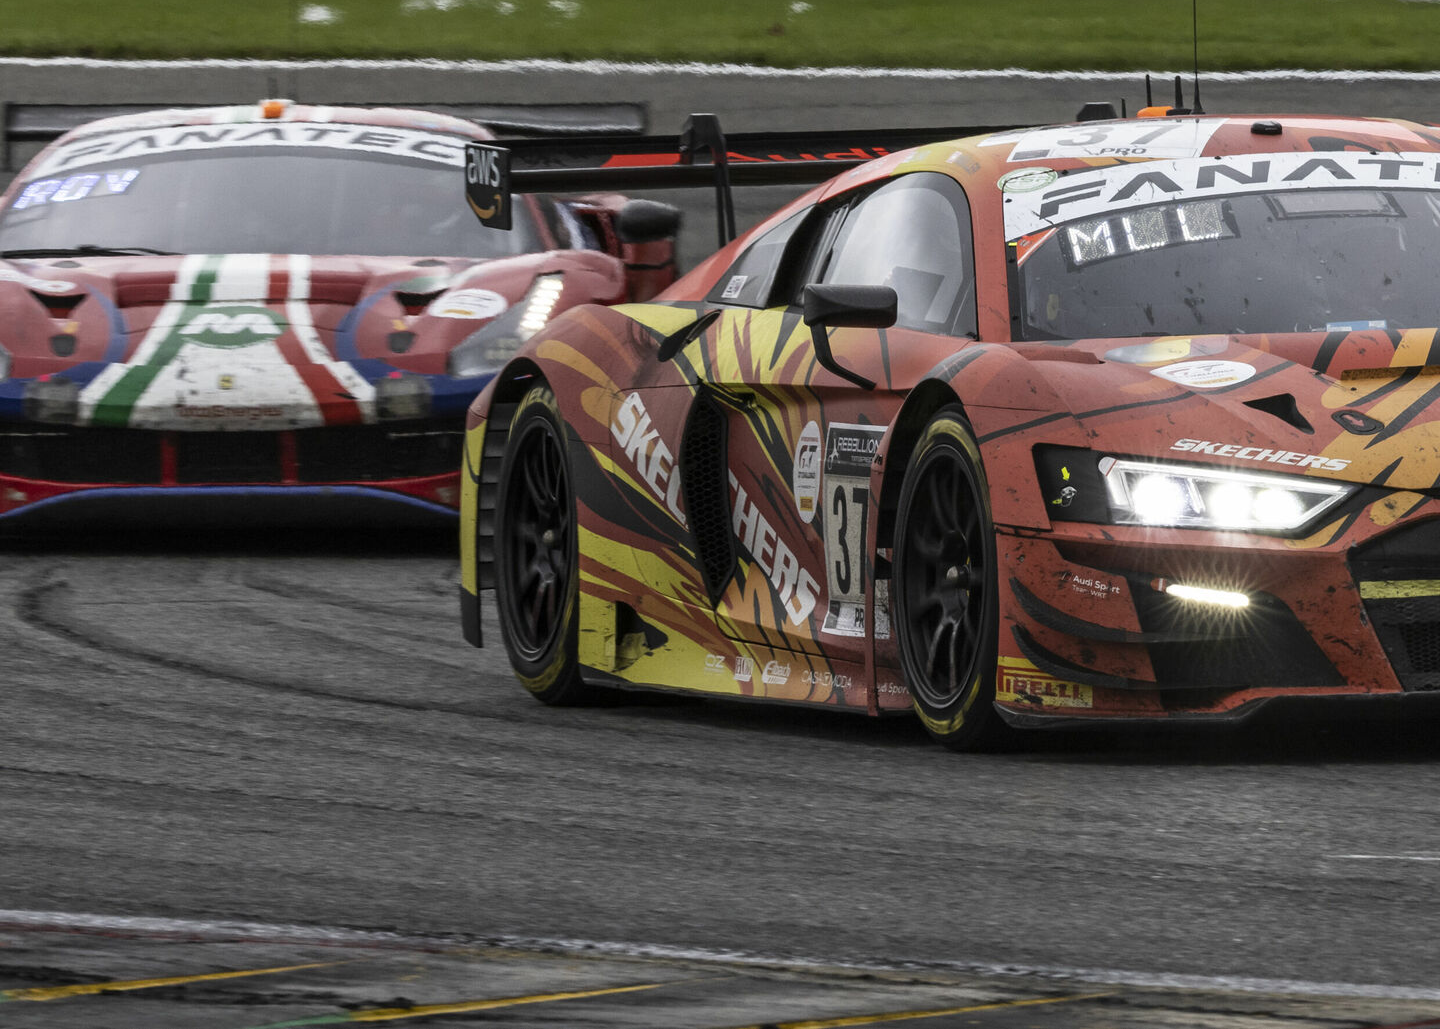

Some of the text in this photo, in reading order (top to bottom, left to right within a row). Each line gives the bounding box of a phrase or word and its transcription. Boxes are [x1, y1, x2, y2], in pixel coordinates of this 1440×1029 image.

[55, 127, 461, 167] FANATEC
[1056, 124, 1184, 147] 37
[1099, 146, 1148, 157] PRO
[466, 148, 500, 188] aws
[1169, 437, 1352, 472] SKECHERS
[832, 484, 869, 596] 37
[1073, 575, 1120, 594] Audi Sprt
[997, 665, 1081, 700] PIRELLI
